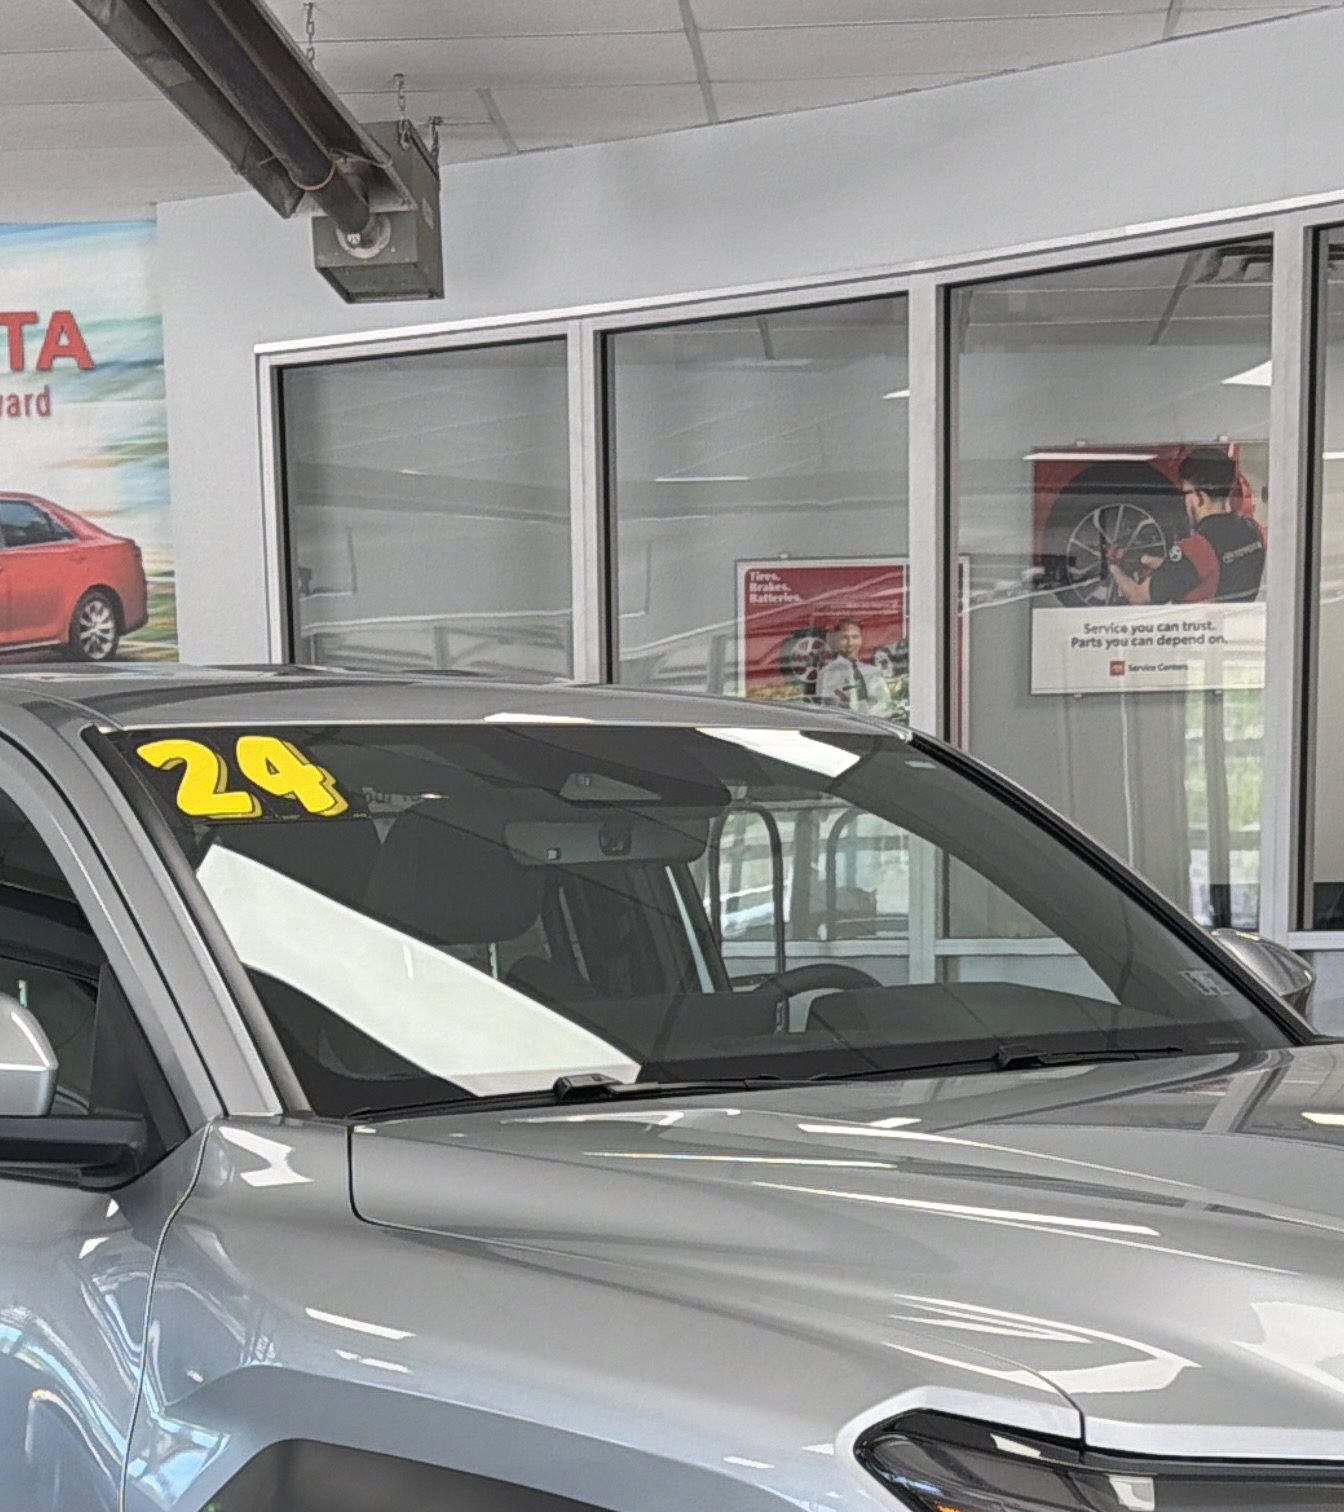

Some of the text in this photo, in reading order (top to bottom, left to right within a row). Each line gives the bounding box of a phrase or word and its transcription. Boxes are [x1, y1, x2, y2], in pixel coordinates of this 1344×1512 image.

[1083, 621, 1217, 636] Service you can trust.
[1071, 634, 1229, 649] Parts you can depend on.
[1127, 663, 1156, 672] Service
[136, 736, 348, 820] 24
